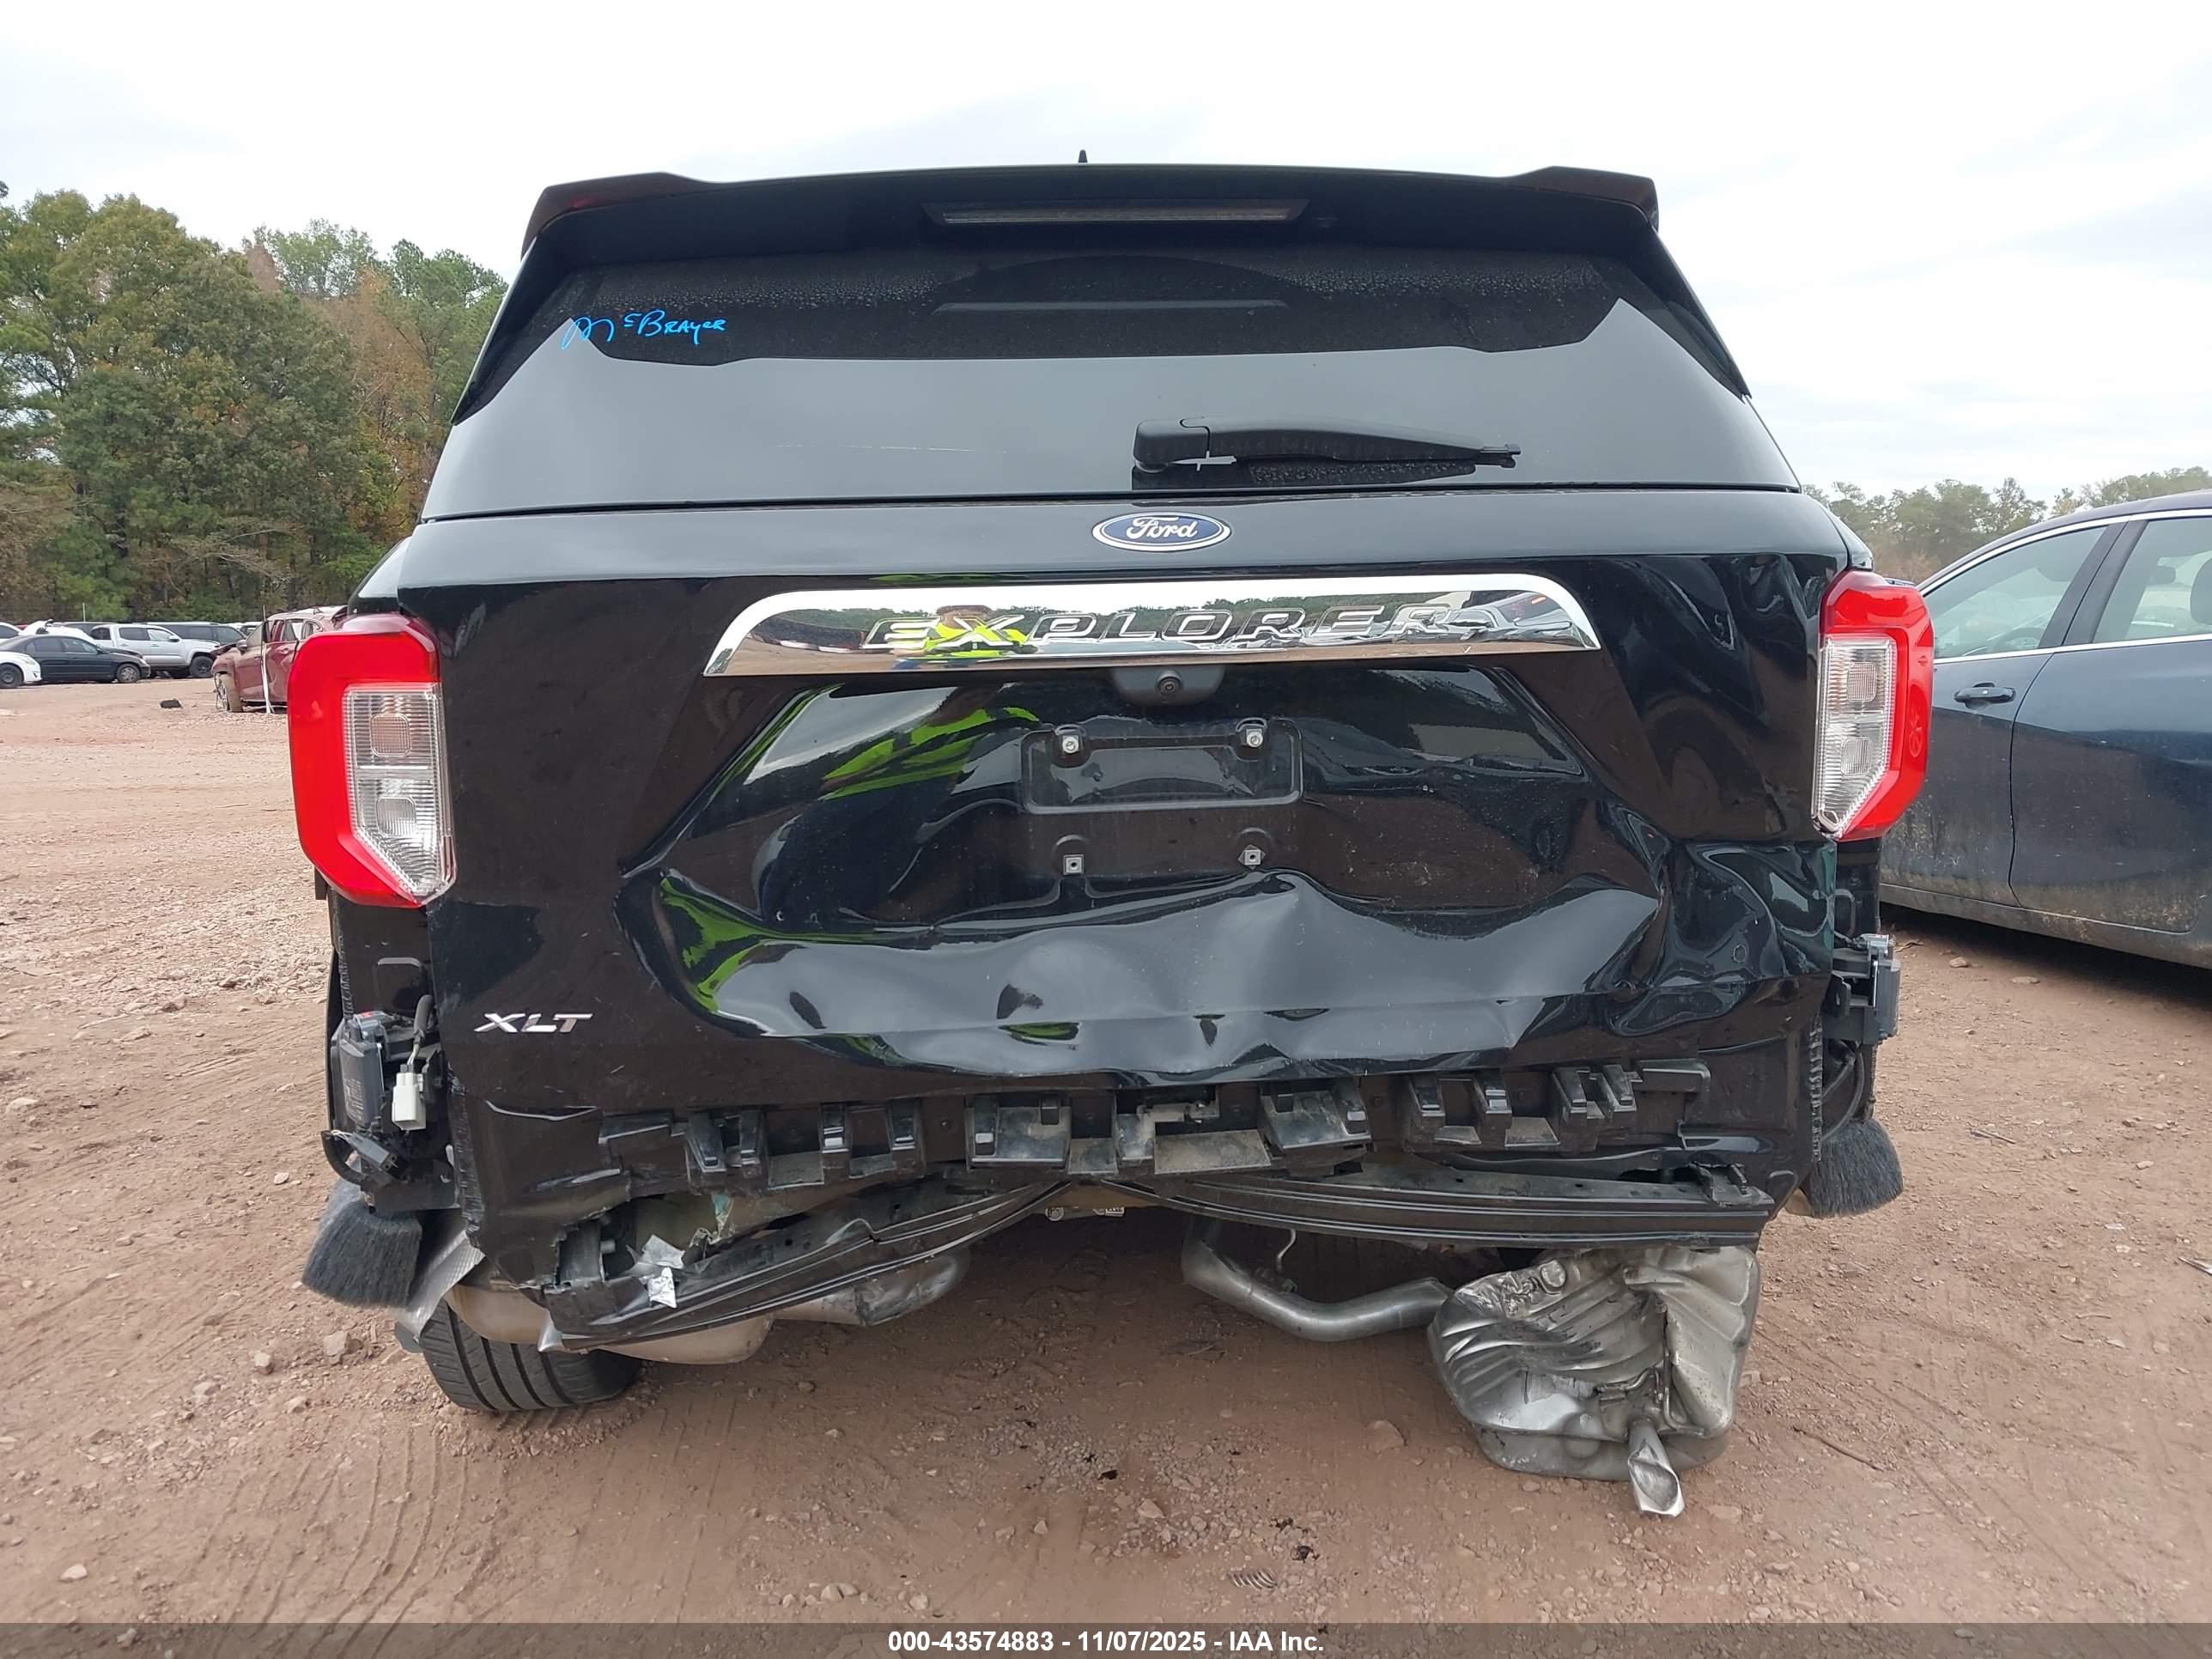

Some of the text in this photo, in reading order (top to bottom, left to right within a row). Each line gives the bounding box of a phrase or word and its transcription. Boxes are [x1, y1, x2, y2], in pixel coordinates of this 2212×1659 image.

[1126, 516, 1198, 540] Ford
[860, 604, 1450, 649] EXPLORER
[473, 1012, 593, 1033] XLT
